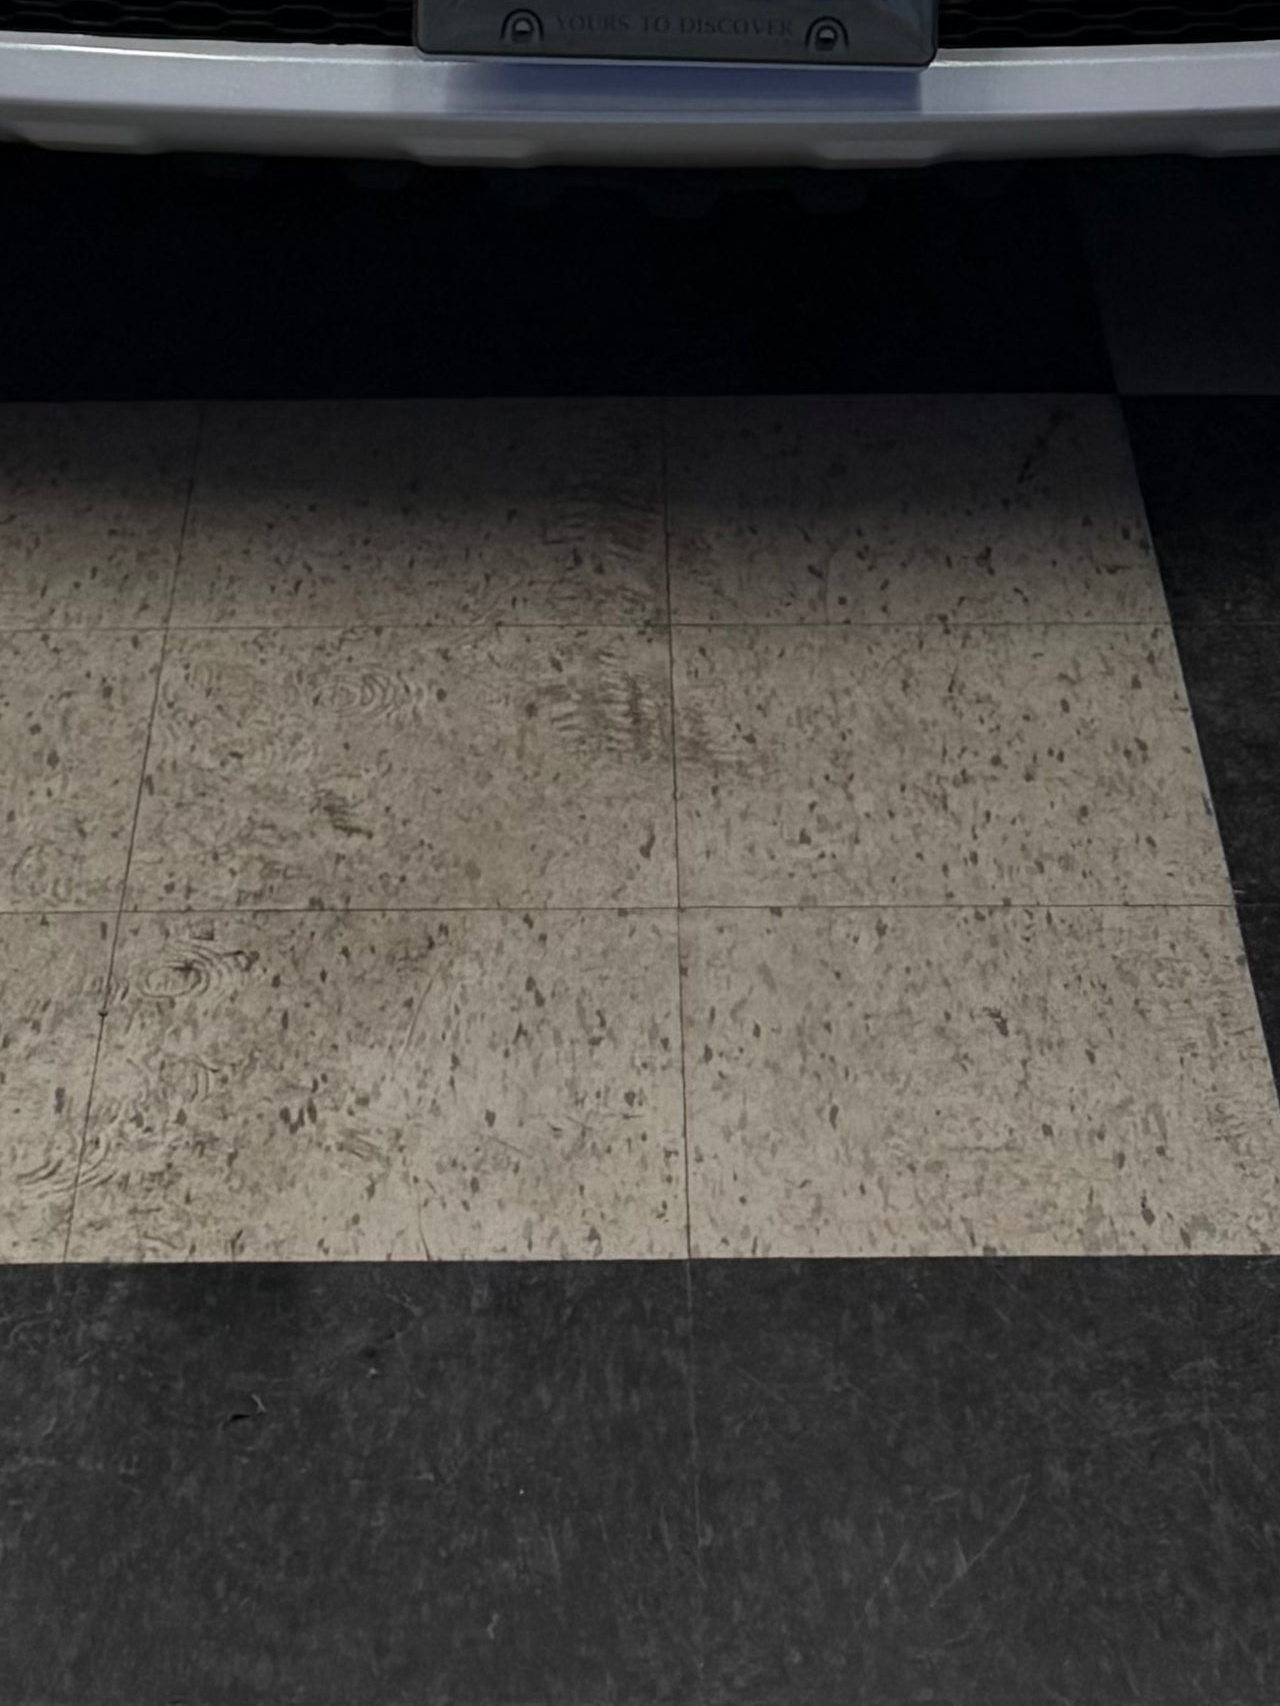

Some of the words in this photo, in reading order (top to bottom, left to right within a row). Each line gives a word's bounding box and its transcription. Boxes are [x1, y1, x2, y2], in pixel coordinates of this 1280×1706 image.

[556, 14, 629, 33] YOURS
[642, 15, 671, 34] TO
[679, 16, 793, 37] DISCOVER
